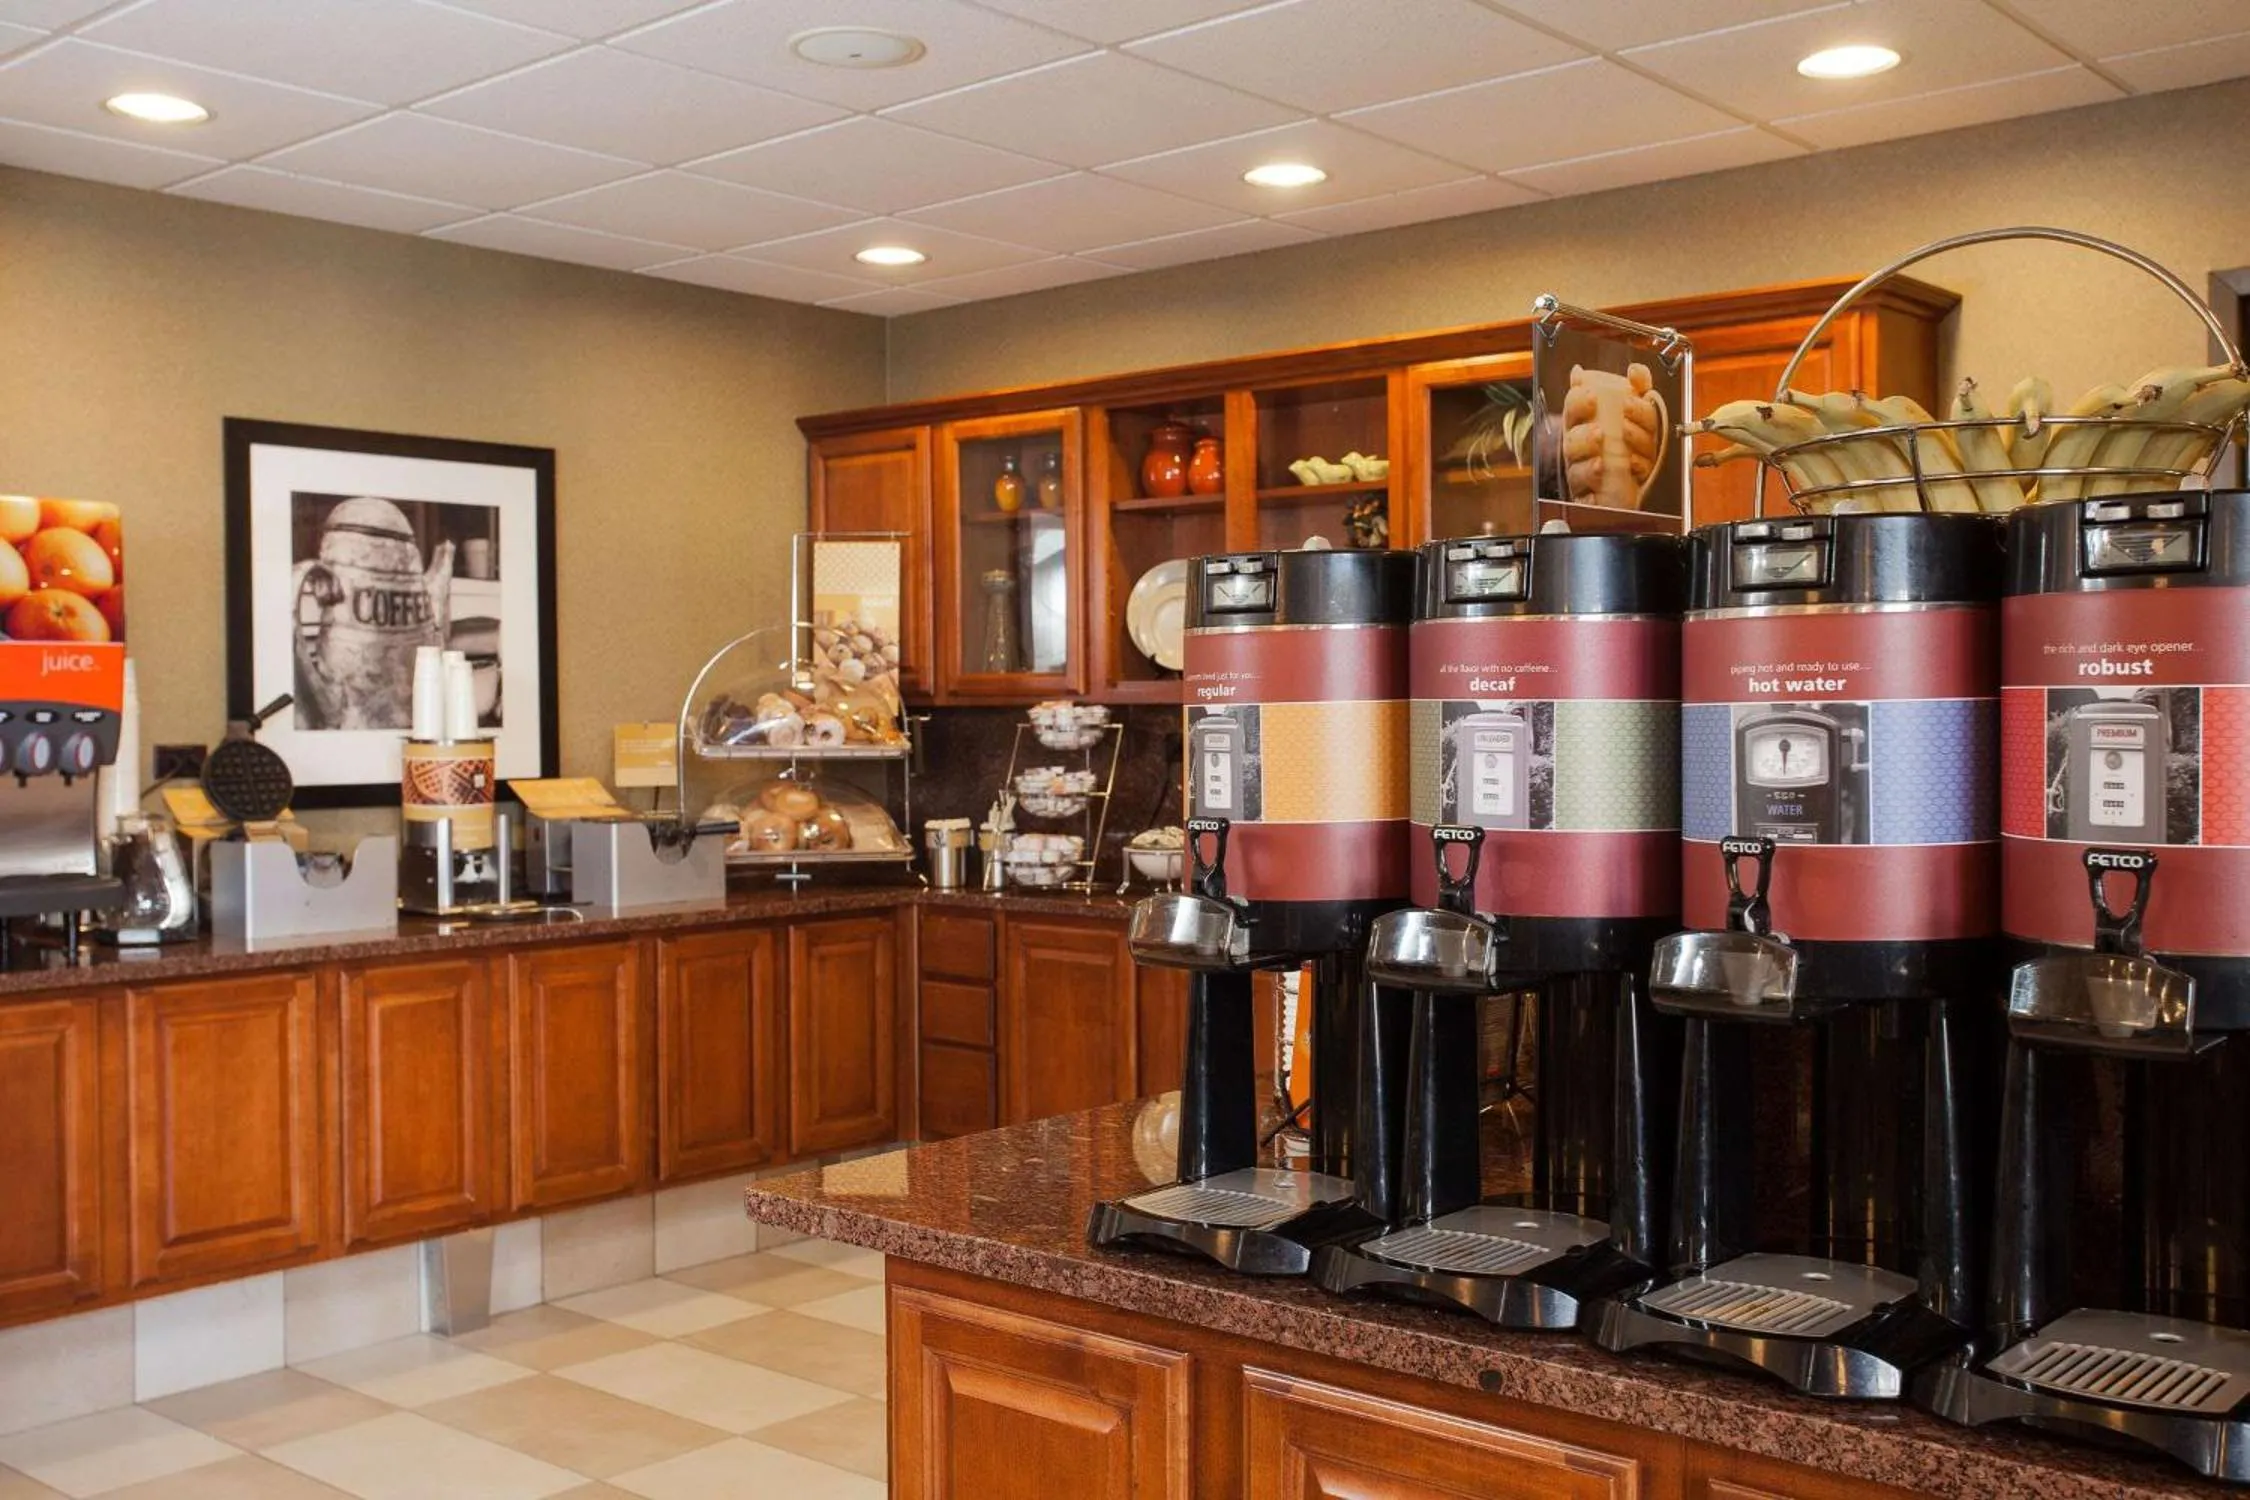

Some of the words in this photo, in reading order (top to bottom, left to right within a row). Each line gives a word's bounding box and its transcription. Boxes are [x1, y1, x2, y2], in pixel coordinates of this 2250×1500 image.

[2099, 641, 2124, 654] dark
[2127, 642, 2147, 655] eye
[1481, 663, 1500, 673] with
[1501, 664, 1513, 673] no
[1758, 662, 1773, 673] hot
[1775, 662, 1794, 672] and
[1797, 661, 1825, 673] ready
[1828, 661, 1839, 671] to
[2078, 658, 2153, 676] robust
[1469, 676, 1517, 692] decaf
[1748, 677, 1780, 693] hot
[1784, 676, 1847, 693] water
[1197, 683, 1237, 700] regular
[1766, 804, 1804, 816] WATER
[1433, 829, 1475, 842] FETCO
[1722, 841, 1763, 854] FETCO
[2087, 852, 2145, 868] FETCO
